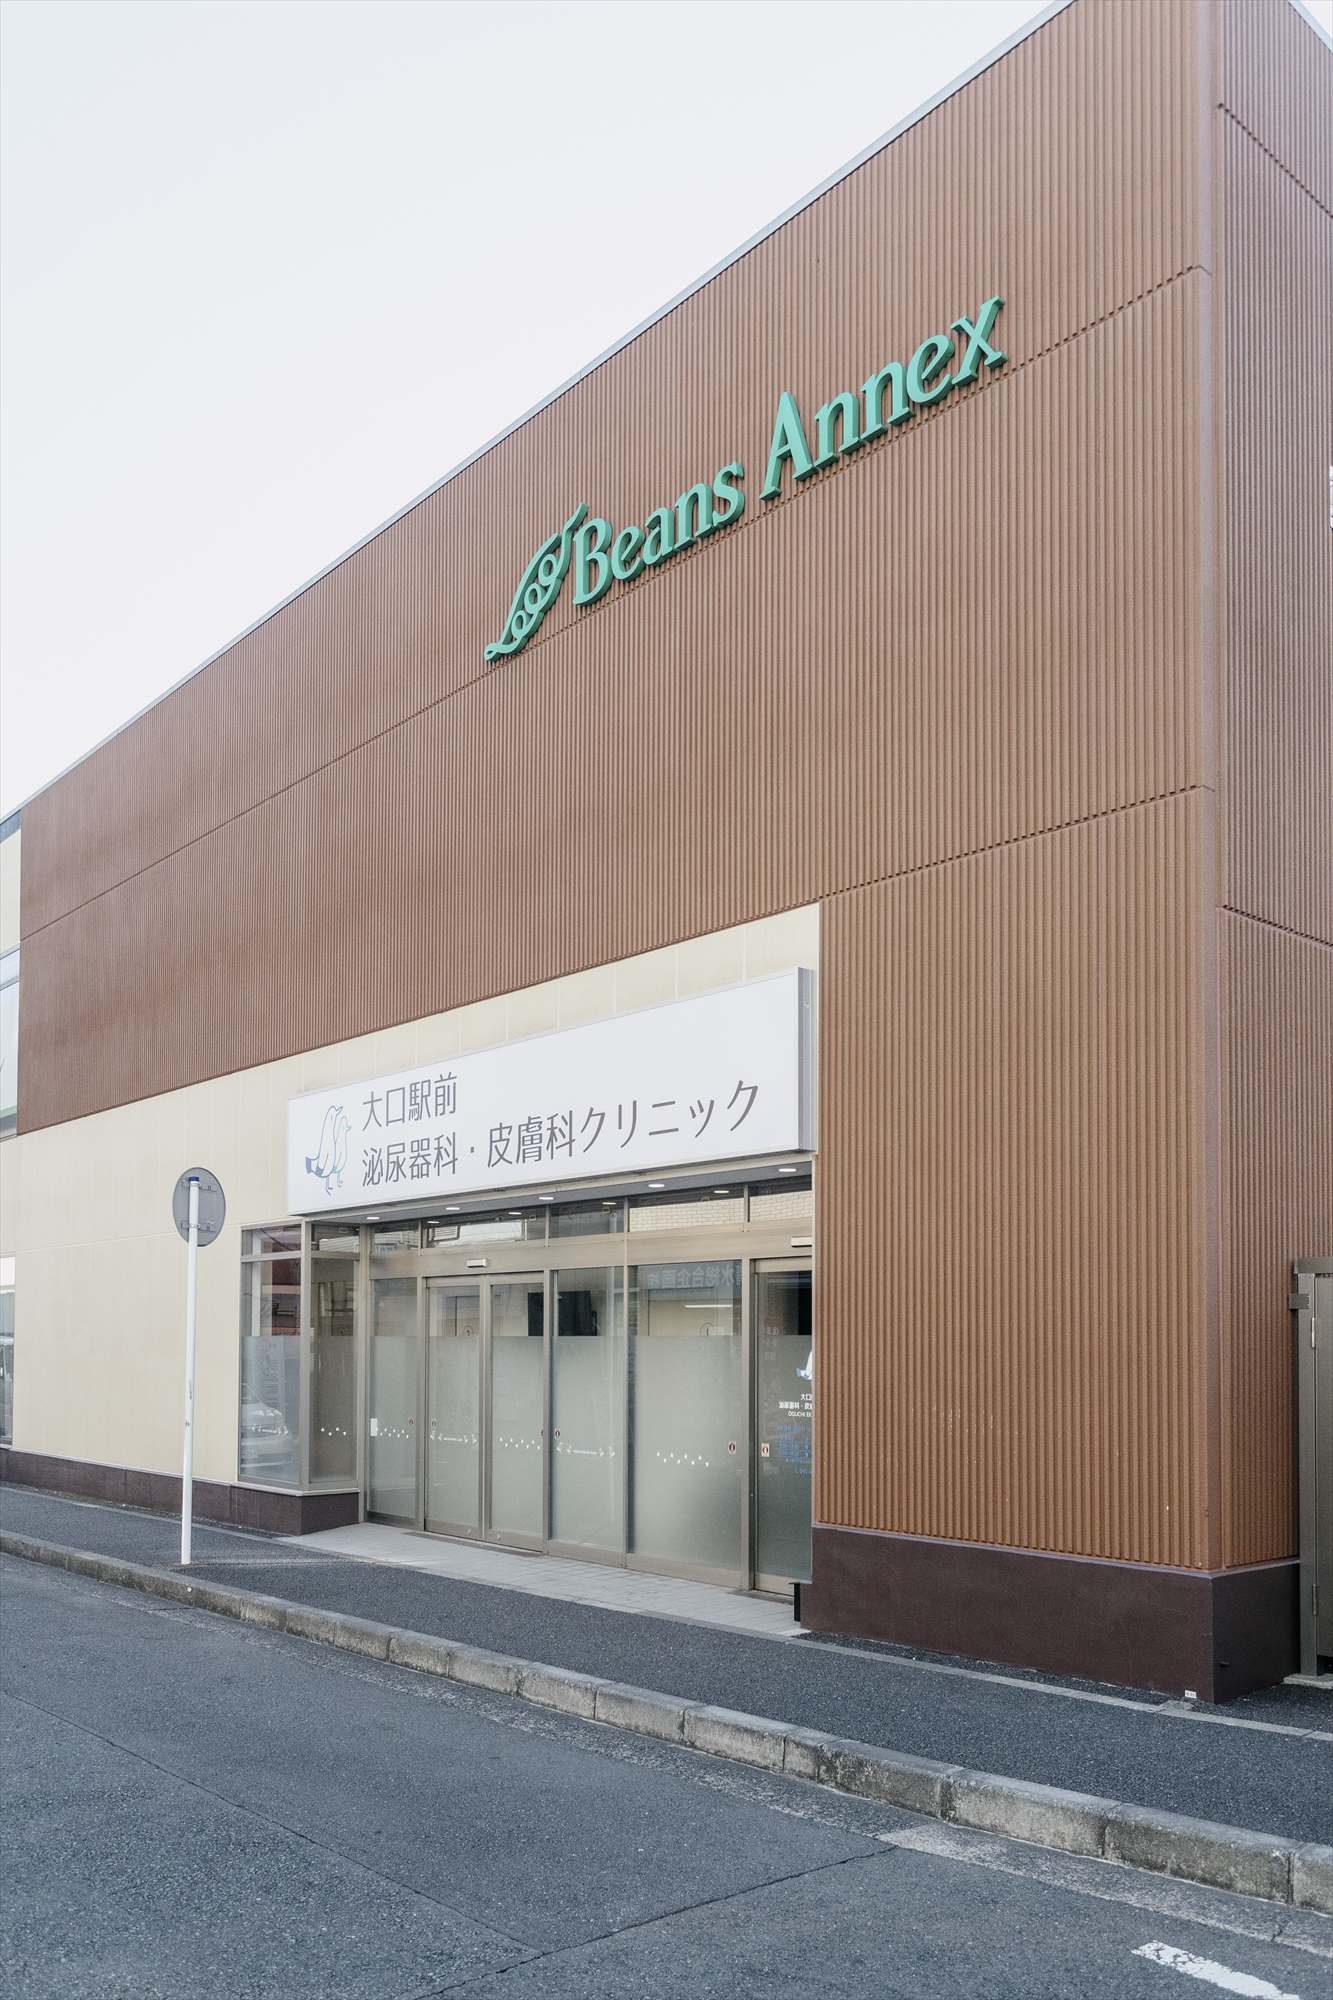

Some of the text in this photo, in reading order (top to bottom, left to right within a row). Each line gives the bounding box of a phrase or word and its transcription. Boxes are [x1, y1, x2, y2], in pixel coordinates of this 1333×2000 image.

[573, 296, 1008, 607] Beans Annex
[362, 1071, 458, 1132] 大口駅前
[362, 1079, 760, 1187] 泌尿器科・皮膚科クリニック
